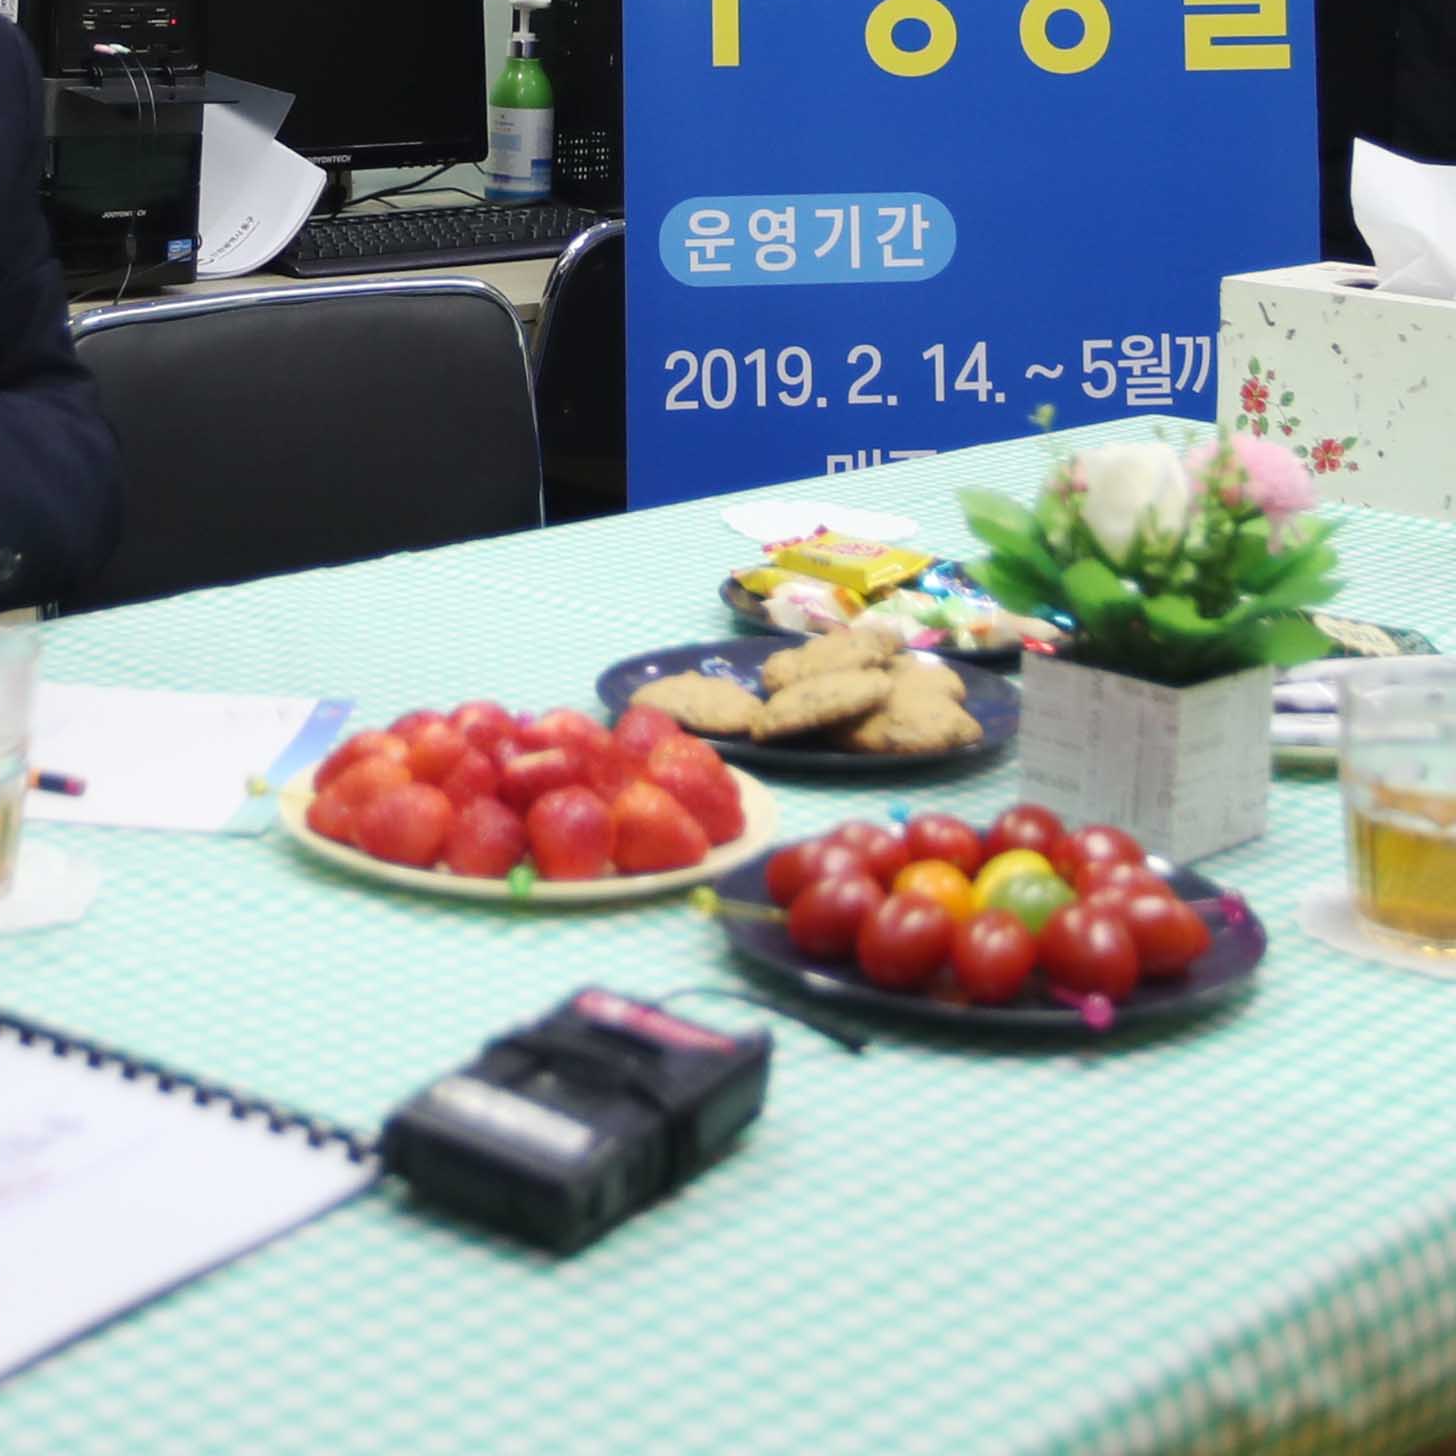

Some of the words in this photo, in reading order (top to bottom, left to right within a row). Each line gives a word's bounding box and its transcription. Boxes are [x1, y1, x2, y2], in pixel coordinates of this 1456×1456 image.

[664, 345, 828, 412] 2019.
[846, 343, 899, 407] 2.
[922, 341, 1006, 404] 14.
